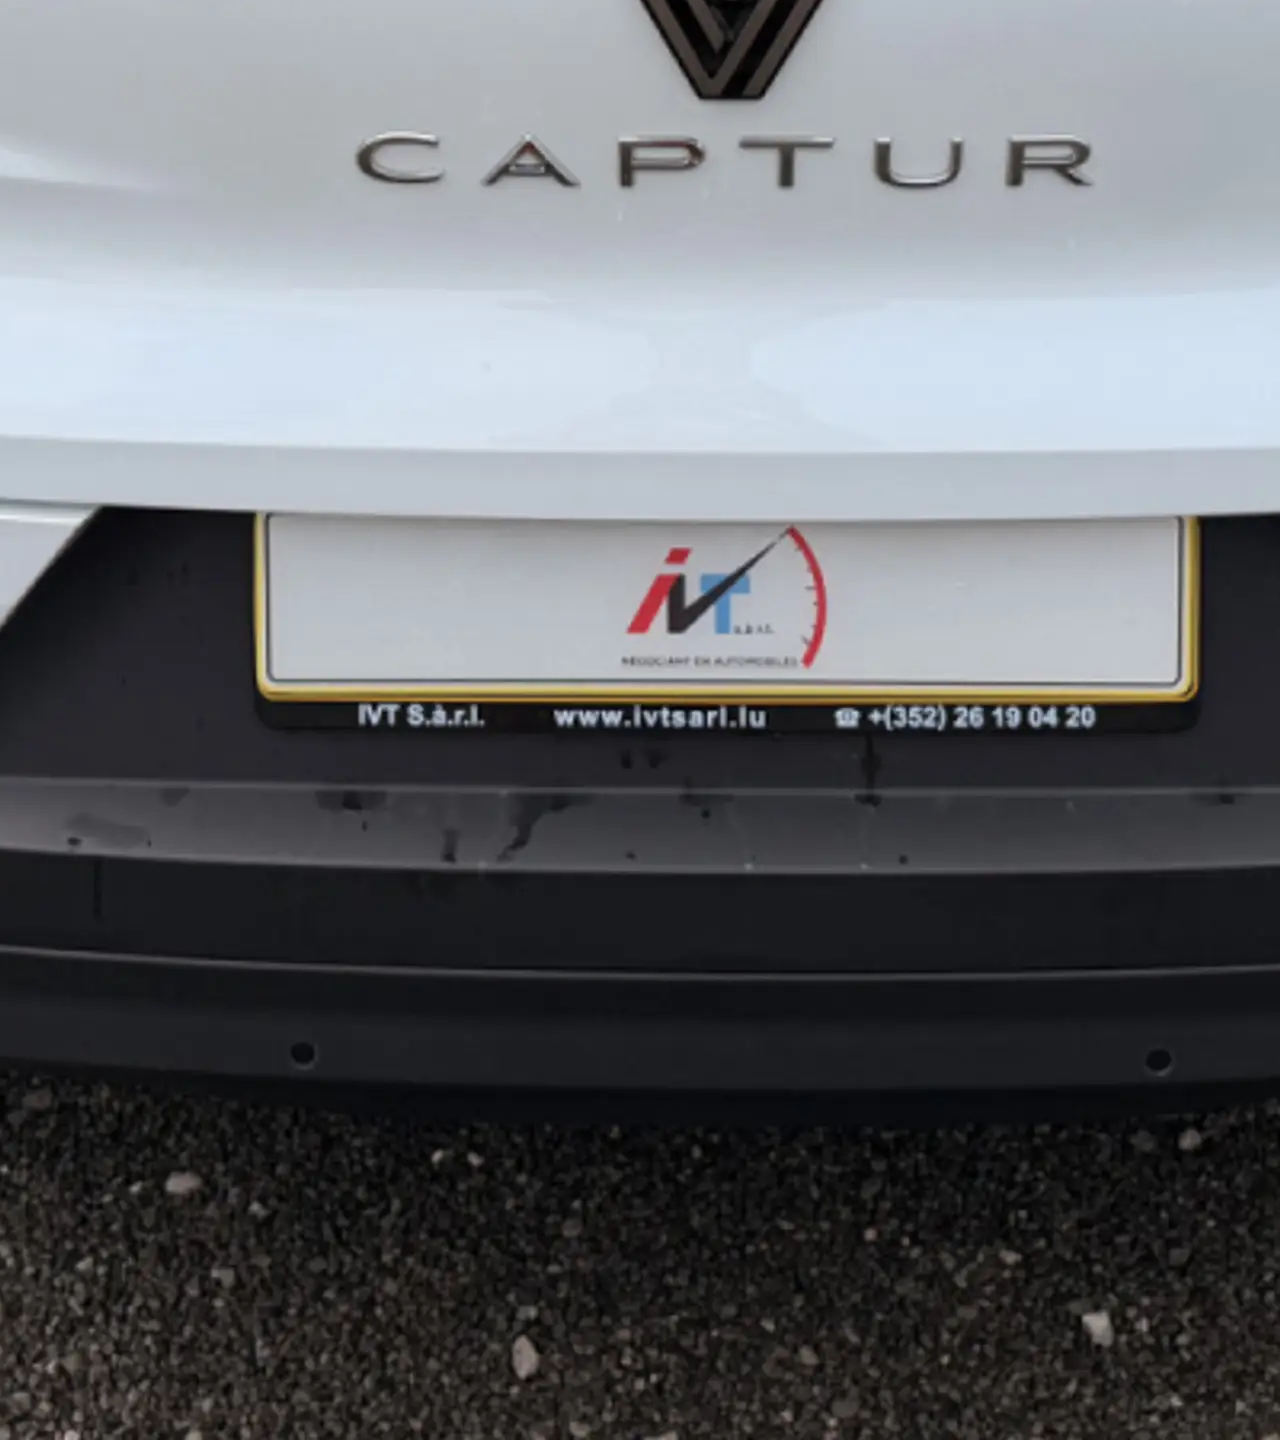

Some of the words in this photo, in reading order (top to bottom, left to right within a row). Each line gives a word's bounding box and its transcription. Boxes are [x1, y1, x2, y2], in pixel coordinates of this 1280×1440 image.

[354, 130, 1095, 190] CAPTUR
[357, 703, 399, 727] IVT
[553, 704, 767, 729] www.ivtsarl.lu
[868, 704, 947, 731] +(352)
[952, 706, 985, 729] 26
[991, 706, 1021, 729] 19
[1027, 706, 1059, 729] 04
[1065, 706, 1097, 729] 20
